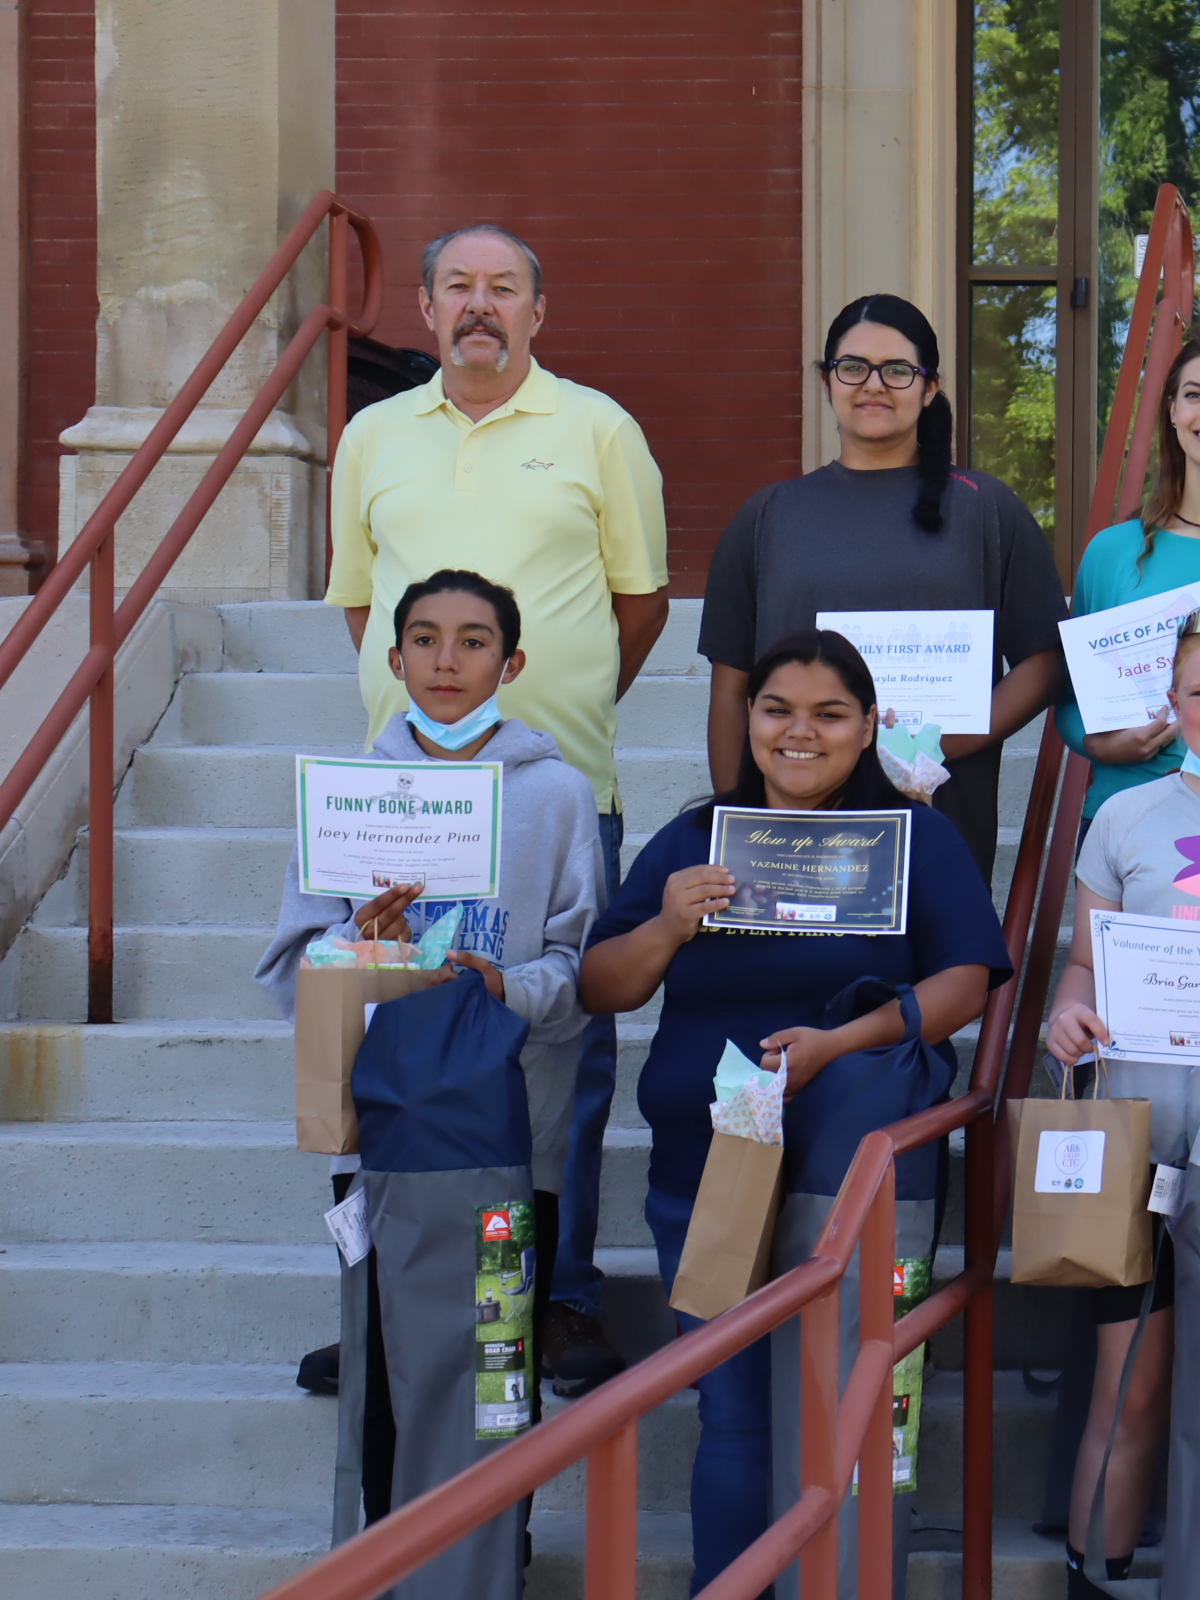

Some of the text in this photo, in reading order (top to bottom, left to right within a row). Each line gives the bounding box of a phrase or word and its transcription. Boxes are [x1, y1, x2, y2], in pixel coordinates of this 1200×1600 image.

[1088, 632, 1130, 650] VOICE
[1134, 625, 1151, 638] OF
[1156, 616, 1183, 633] ACT
[857, 644, 971, 654] MILY FIRST AWARD
[1117, 656, 1174, 679] Jade Sy
[874, 674, 953, 684] ayla Rodriguez
[326, 796, 473, 814] FUNNY BONE AWARD
[317, 826, 481, 844] Joey Hernandez Pina
[745, 829, 885, 853] Glow up Award
[749, 860, 868, 873] YAZMINE HERNANDEZ
[1112, 938, 1160, 952] Volunteer
[1163, 945, 1175, 955] of
[1177, 946, 1193, 955] the
[1142, 972, 1175, 987] Bria
[1064, 1144, 1081, 1152] ARK
[1062, 1159, 1080, 1167] CTC
